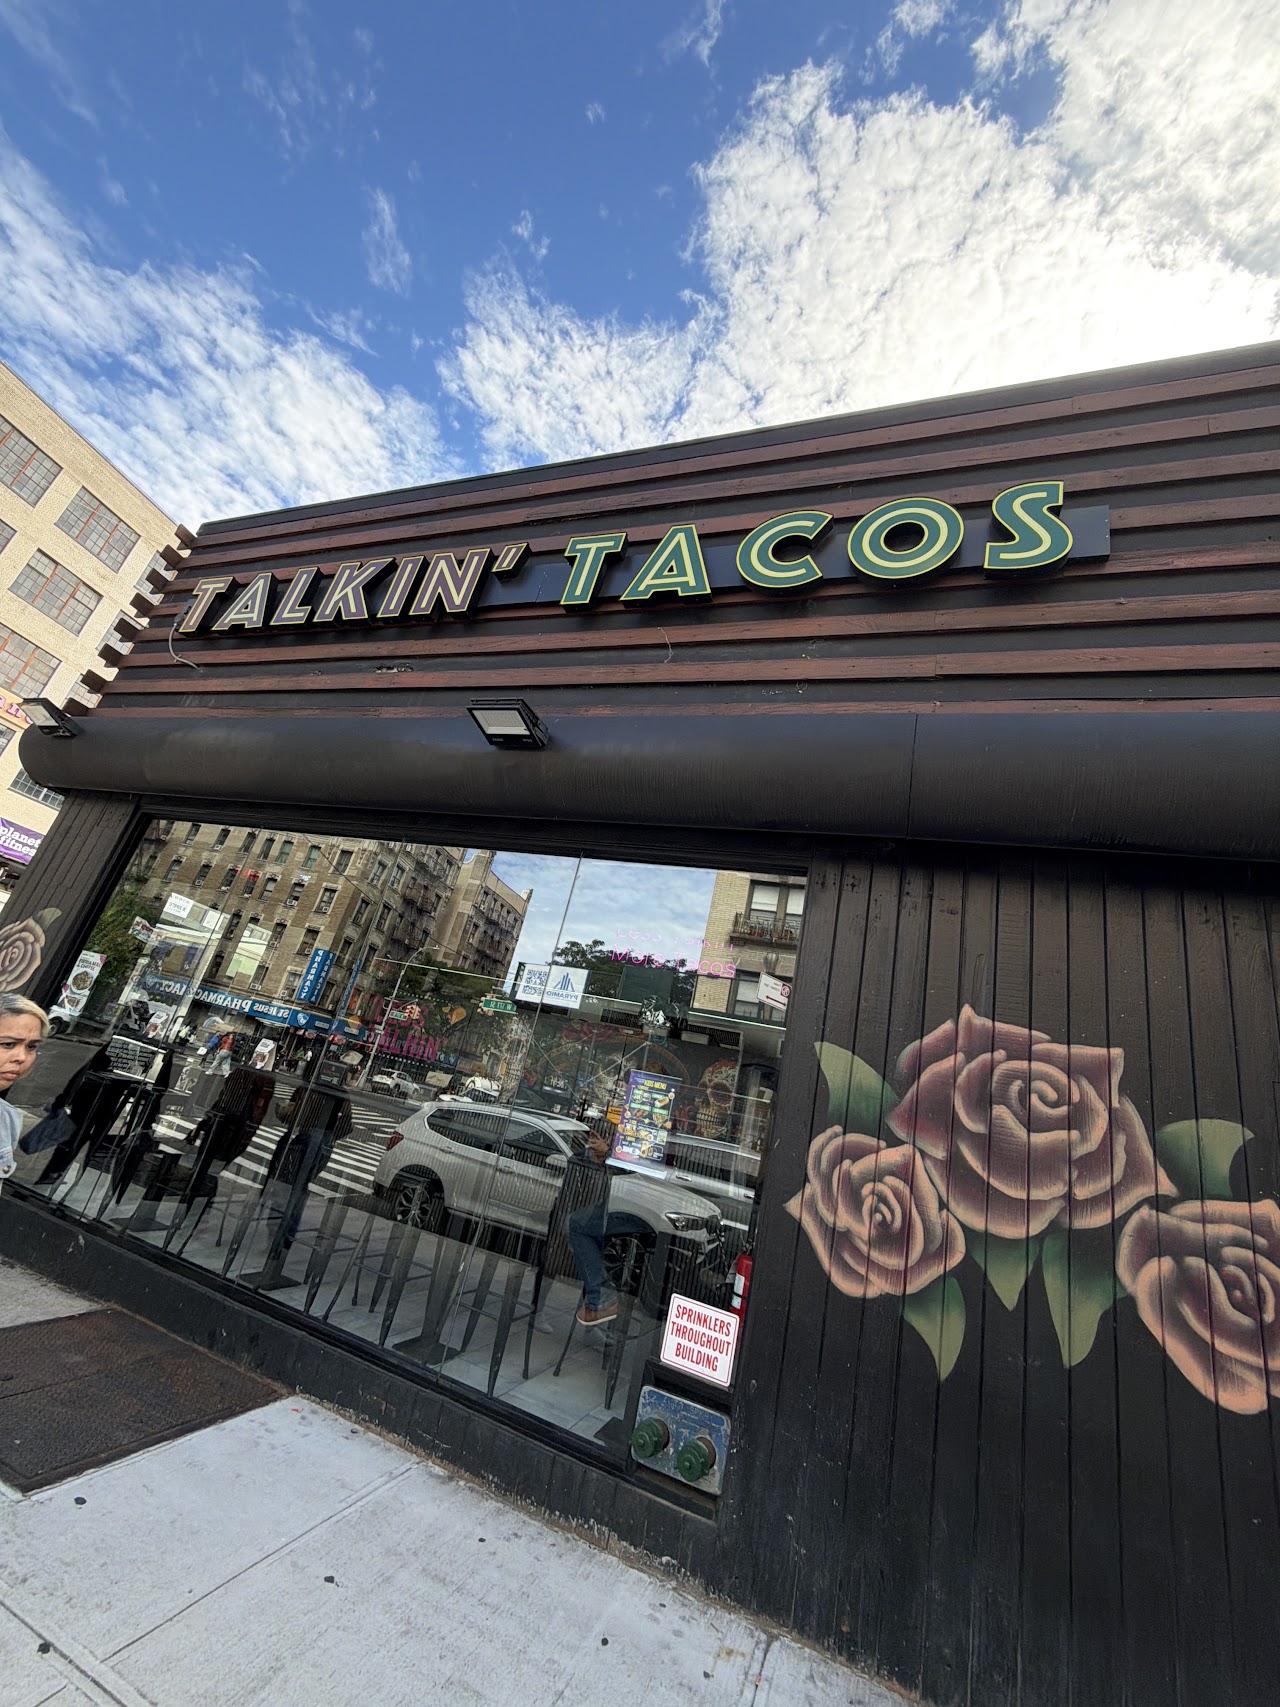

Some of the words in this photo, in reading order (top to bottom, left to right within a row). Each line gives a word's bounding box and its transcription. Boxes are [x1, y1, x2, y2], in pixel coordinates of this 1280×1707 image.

[178, 541, 531, 633] TALKIN'
[560, 481, 1073, 605] TACOS
[0, 826, 41, 848] planet
[675, 1304, 732, 1337] SPRINKLERS
[671, 1320, 732, 1357] THROUGHOUT
[675, 1342, 719, 1372] BUILDING
